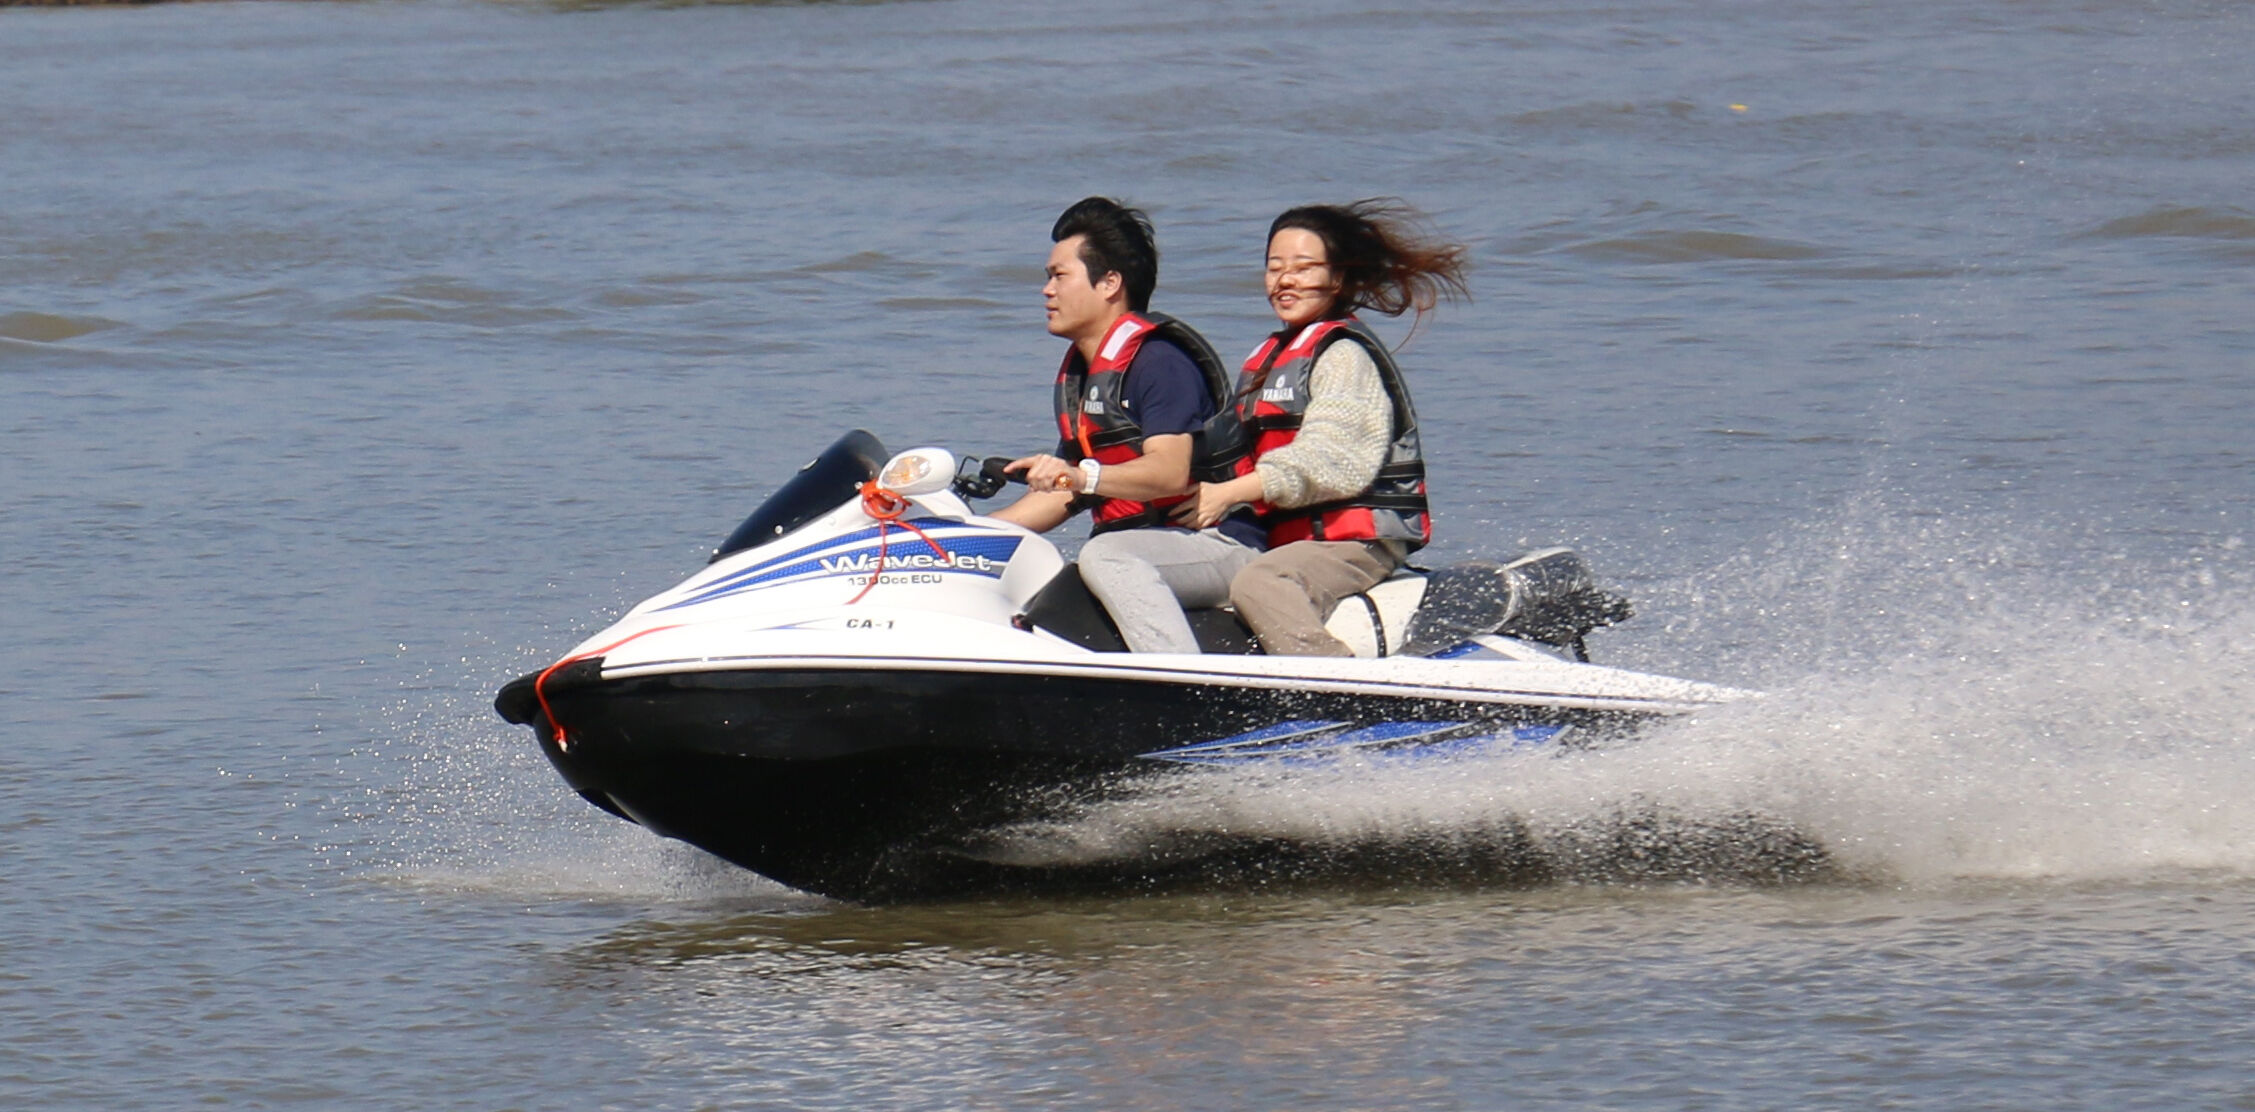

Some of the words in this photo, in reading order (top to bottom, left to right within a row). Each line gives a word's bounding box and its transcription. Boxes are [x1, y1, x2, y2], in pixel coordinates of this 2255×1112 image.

[820, 551, 991, 573] WaveJet
[911, 574, 942, 584] ECU
[846, 618, 894, 629] CA-1
